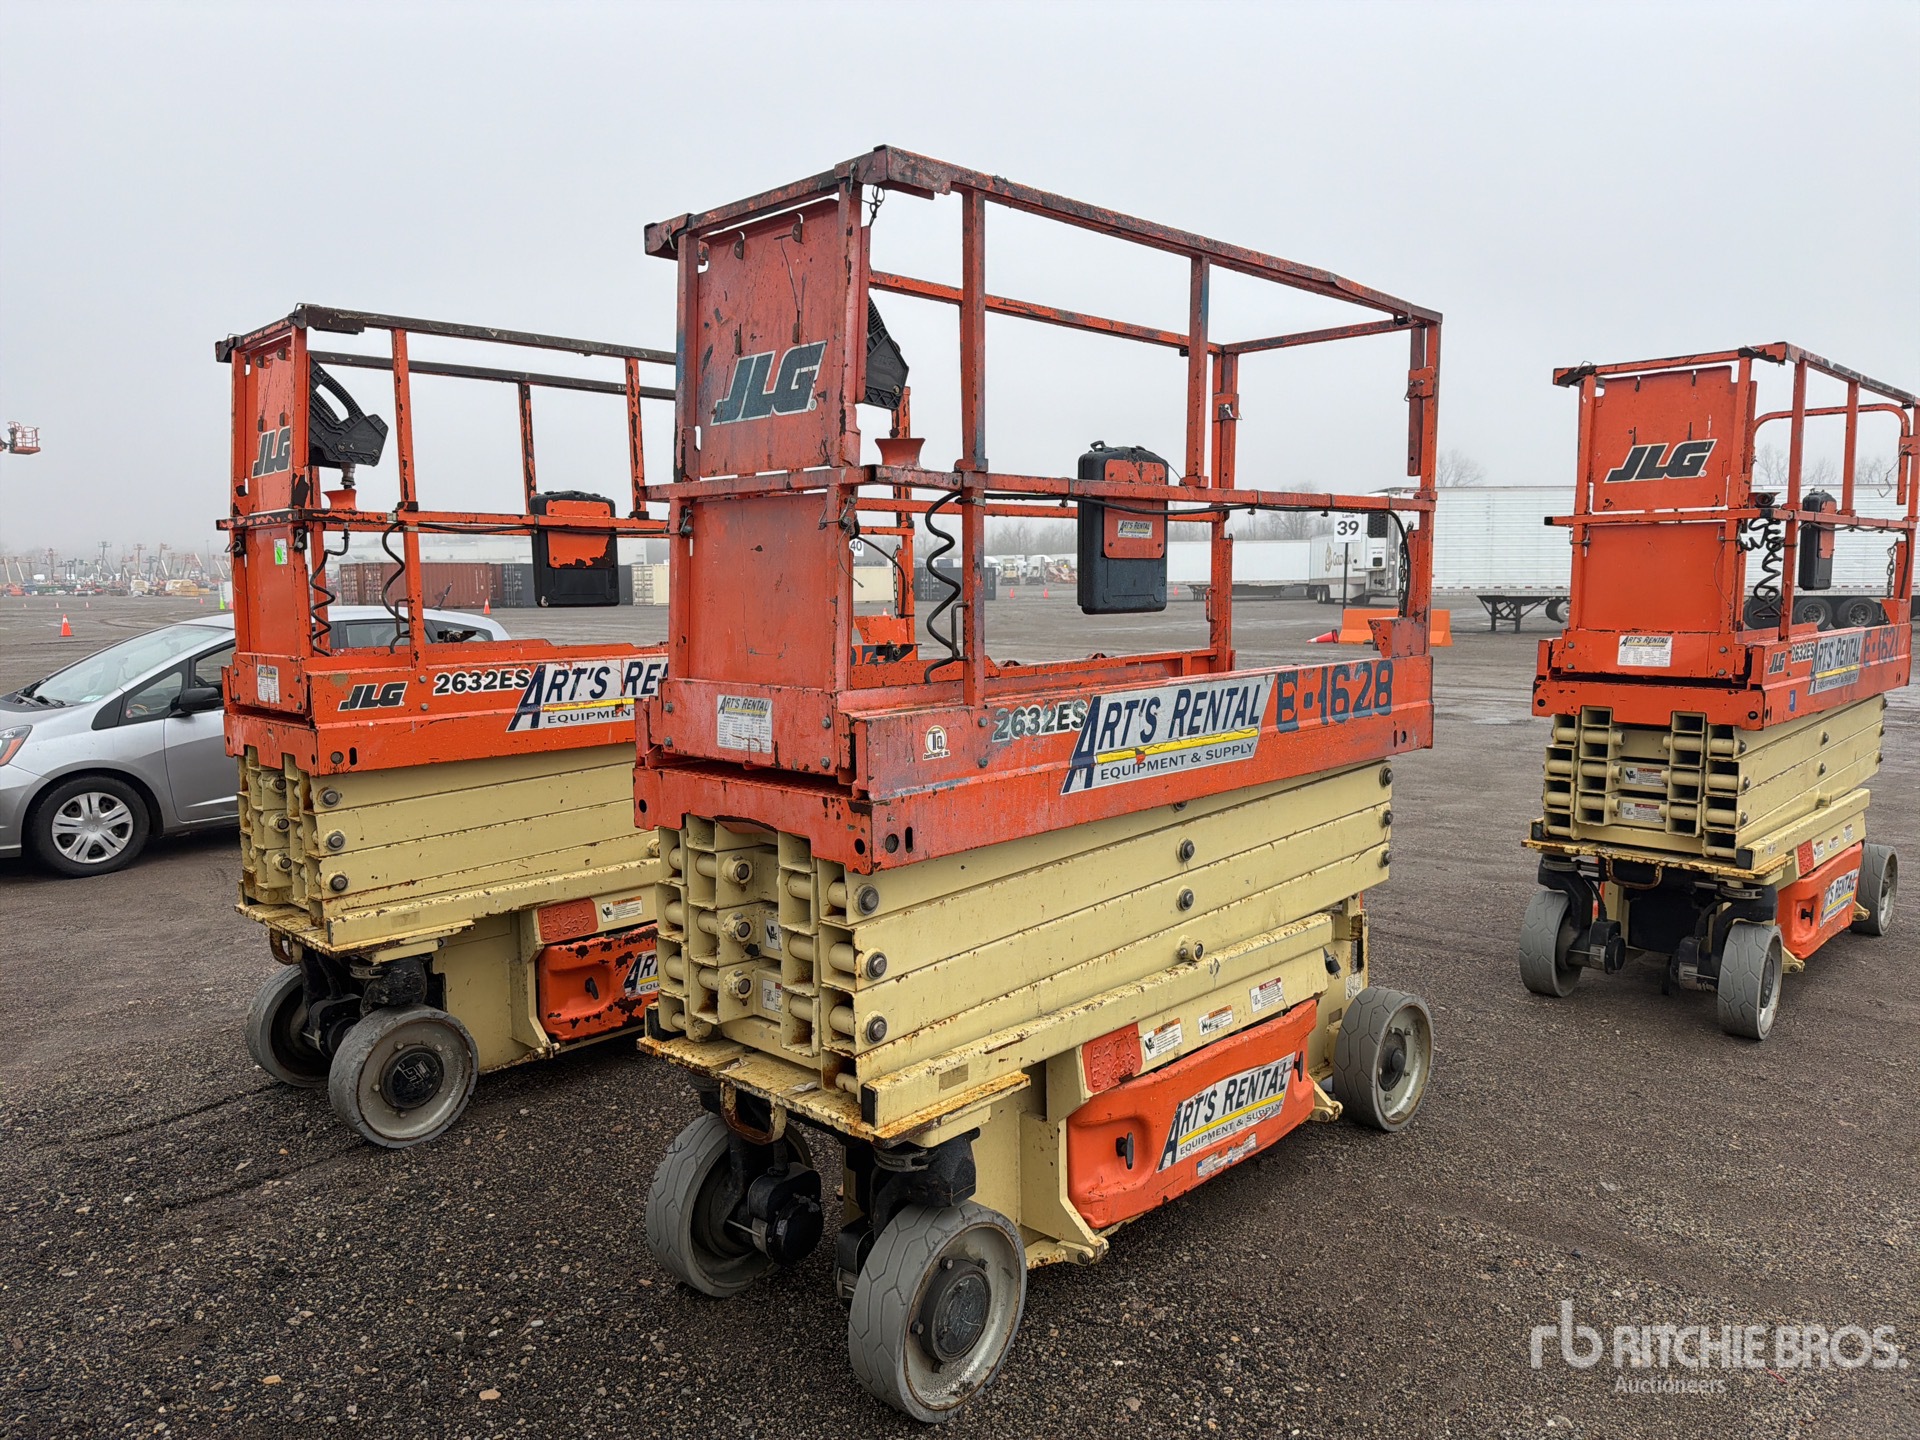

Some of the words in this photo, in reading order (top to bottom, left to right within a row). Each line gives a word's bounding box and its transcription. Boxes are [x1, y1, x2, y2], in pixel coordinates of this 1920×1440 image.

[710, 340, 827, 426] JLG
[1603, 438, 1718, 484] JLG
[850, 540, 863, 552] 40
[1337, 520, 1360, 536] 39
[1643, 636, 1670, 644] RENTAL
[433, 669, 532, 695] 2632ES
[1768, 651, 1787, 675] JLG
[1808, 638, 1834, 695] ART'S
[1834, 637, 1861, 668] RENTAL
[338, 681, 408, 711] JLG
[507, 664, 611, 732] ART'S
[718, 696, 741, 714] ART'S
[742, 698, 770, 712] RENTAL
[1276, 660, 1394, 734] E-1628
[992, 699, 1089, 743] 2632ES
[1061, 694, 1161, 794] ART'S
[1168, 684, 1261, 739] RENTAL
[1101, 752, 1187, 781] EQUIPMENT
[1190, 752, 1202, 763] &
[1205, 742, 1255, 761] SUPPLY
[1158, 1088, 1218, 1171] ART'S
[1222, 1061, 1288, 1116] RENTAL
[1179, 1122, 1234, 1155] EQUIPMENT
[1236, 1118, 1244, 1127] &
[1245, 1102, 1282, 1121] SUPPLY
